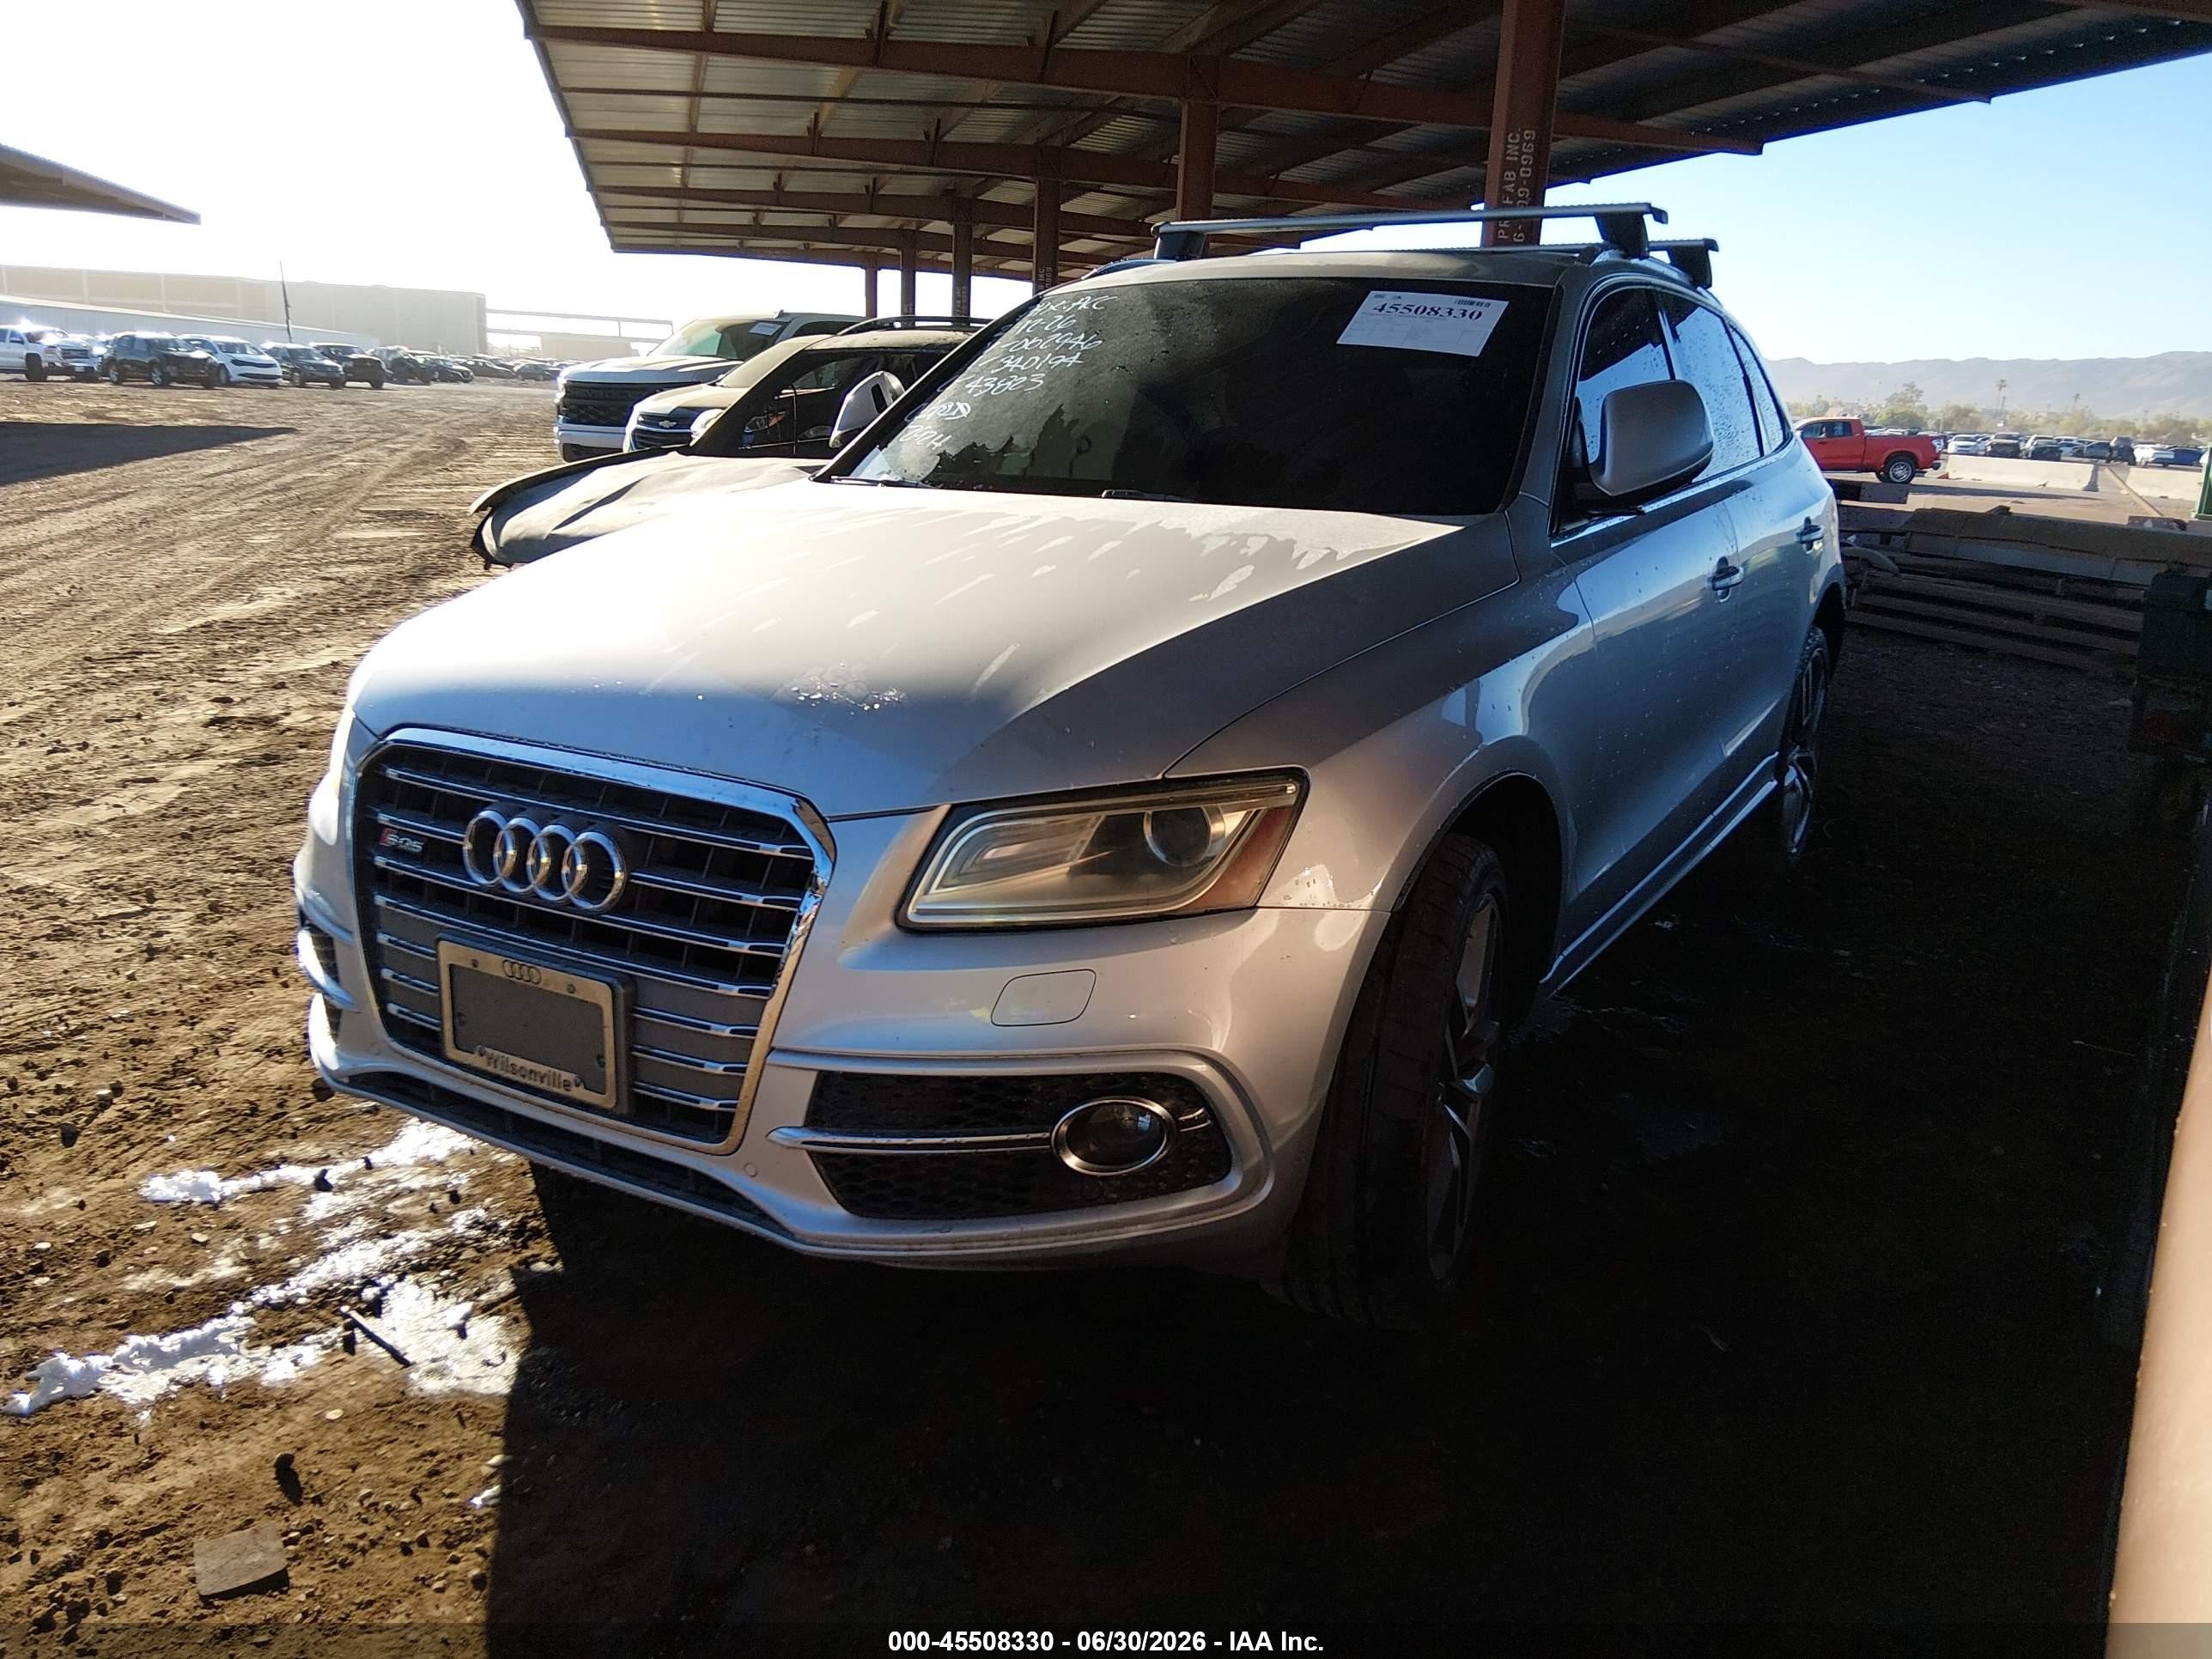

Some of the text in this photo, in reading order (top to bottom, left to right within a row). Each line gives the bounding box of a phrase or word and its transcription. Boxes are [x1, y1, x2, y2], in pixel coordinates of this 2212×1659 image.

[1498, 128, 1522, 240] PRFAB INC.
[1374, 302, 1483, 320] 45508330
[386, 833, 424, 853] SQ5
